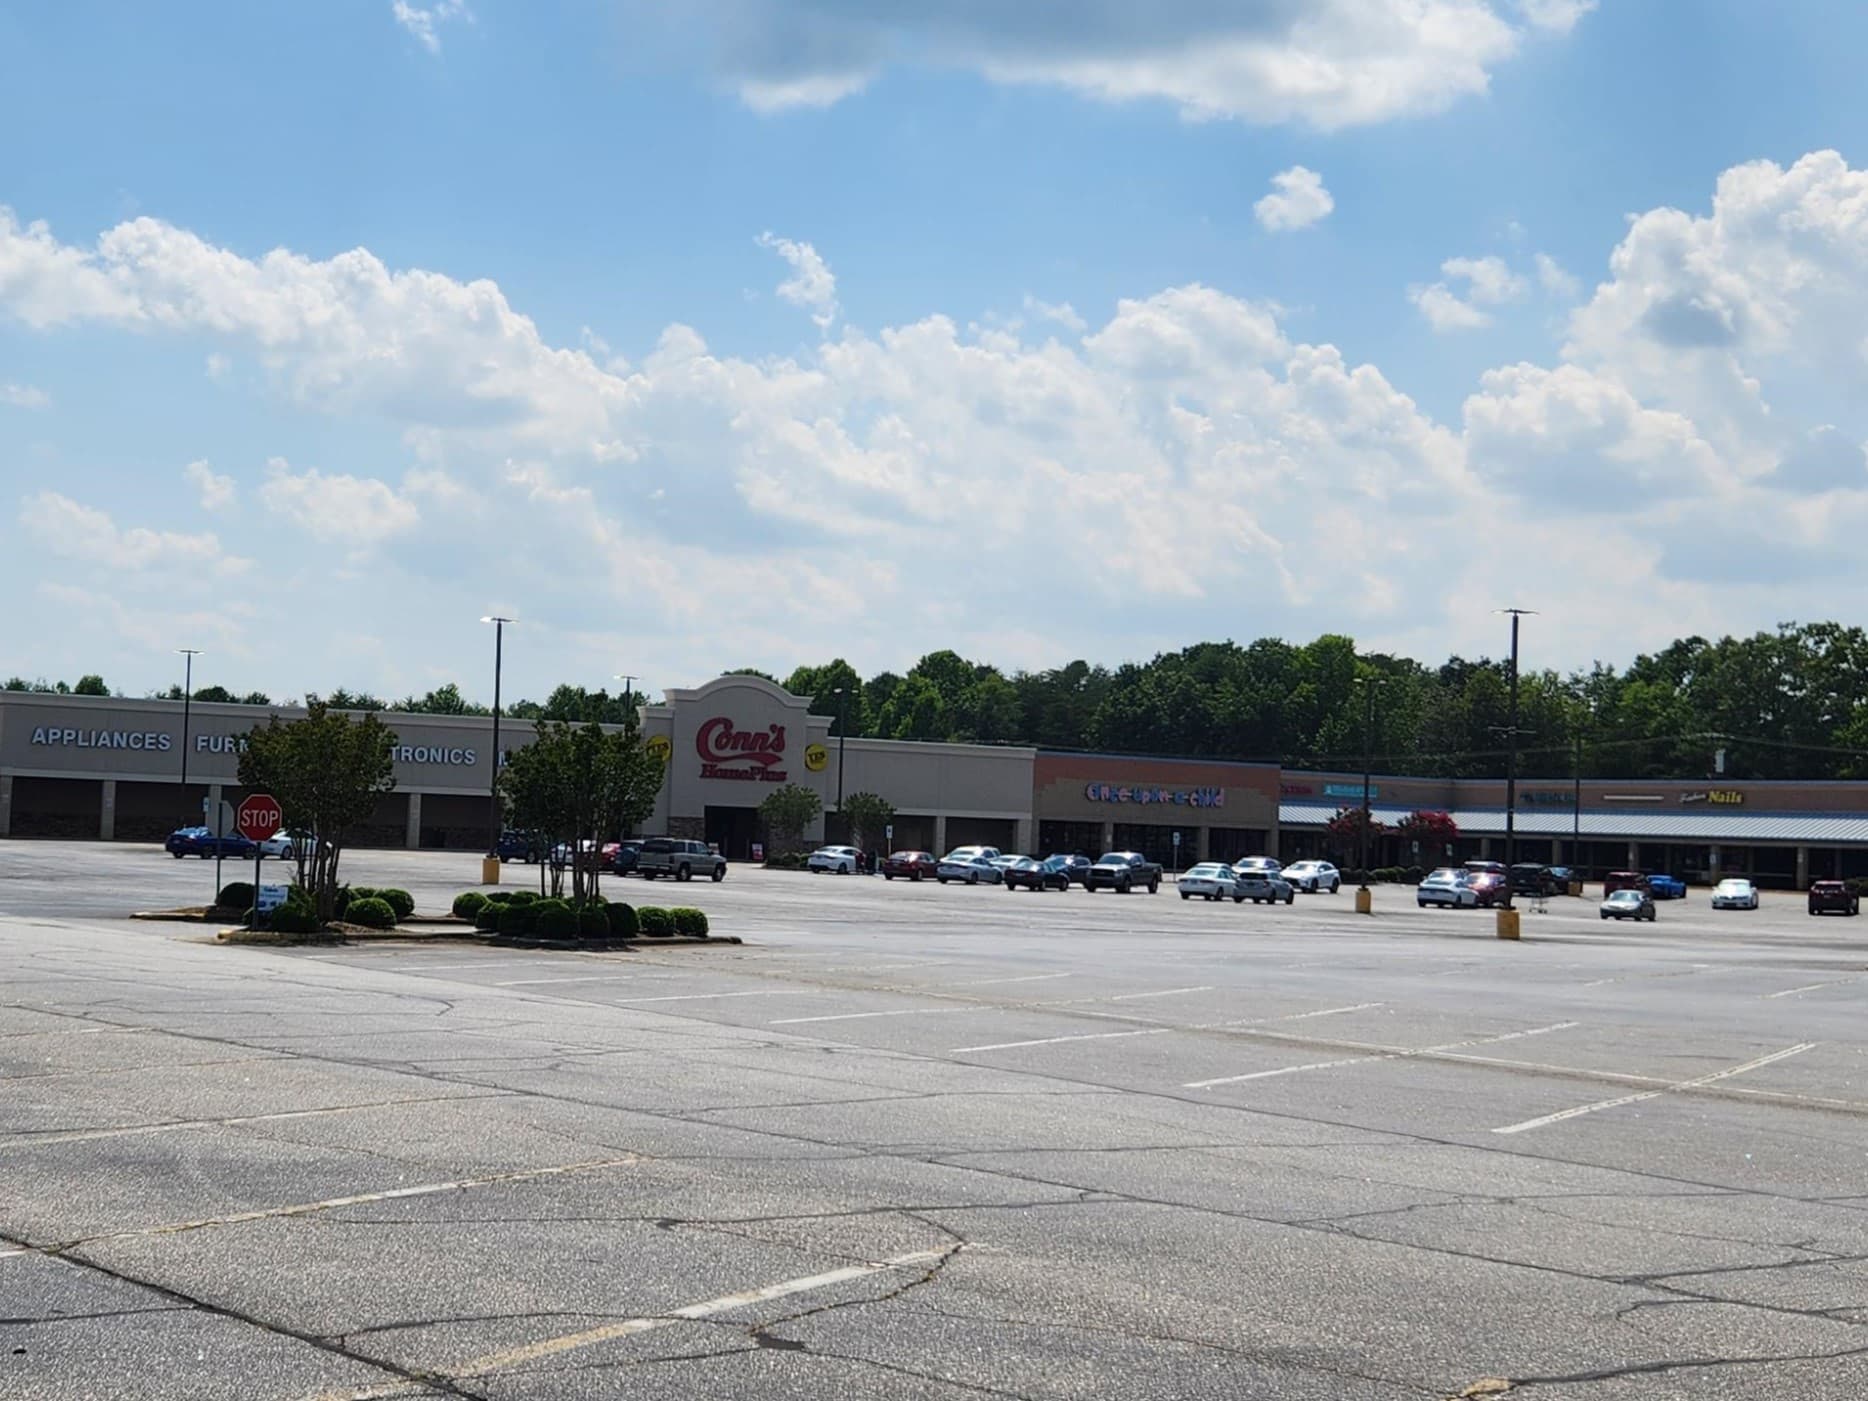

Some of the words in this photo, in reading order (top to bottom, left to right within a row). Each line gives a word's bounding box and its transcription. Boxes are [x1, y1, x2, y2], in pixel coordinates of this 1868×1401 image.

[31, 727, 172, 752] APPLIANCES
[391, 746, 477, 767] TRONICS
[696, 717, 786, 764] Conn's
[1707, 789, 1743, 804] Nails
[241, 809, 278, 827] STOP
